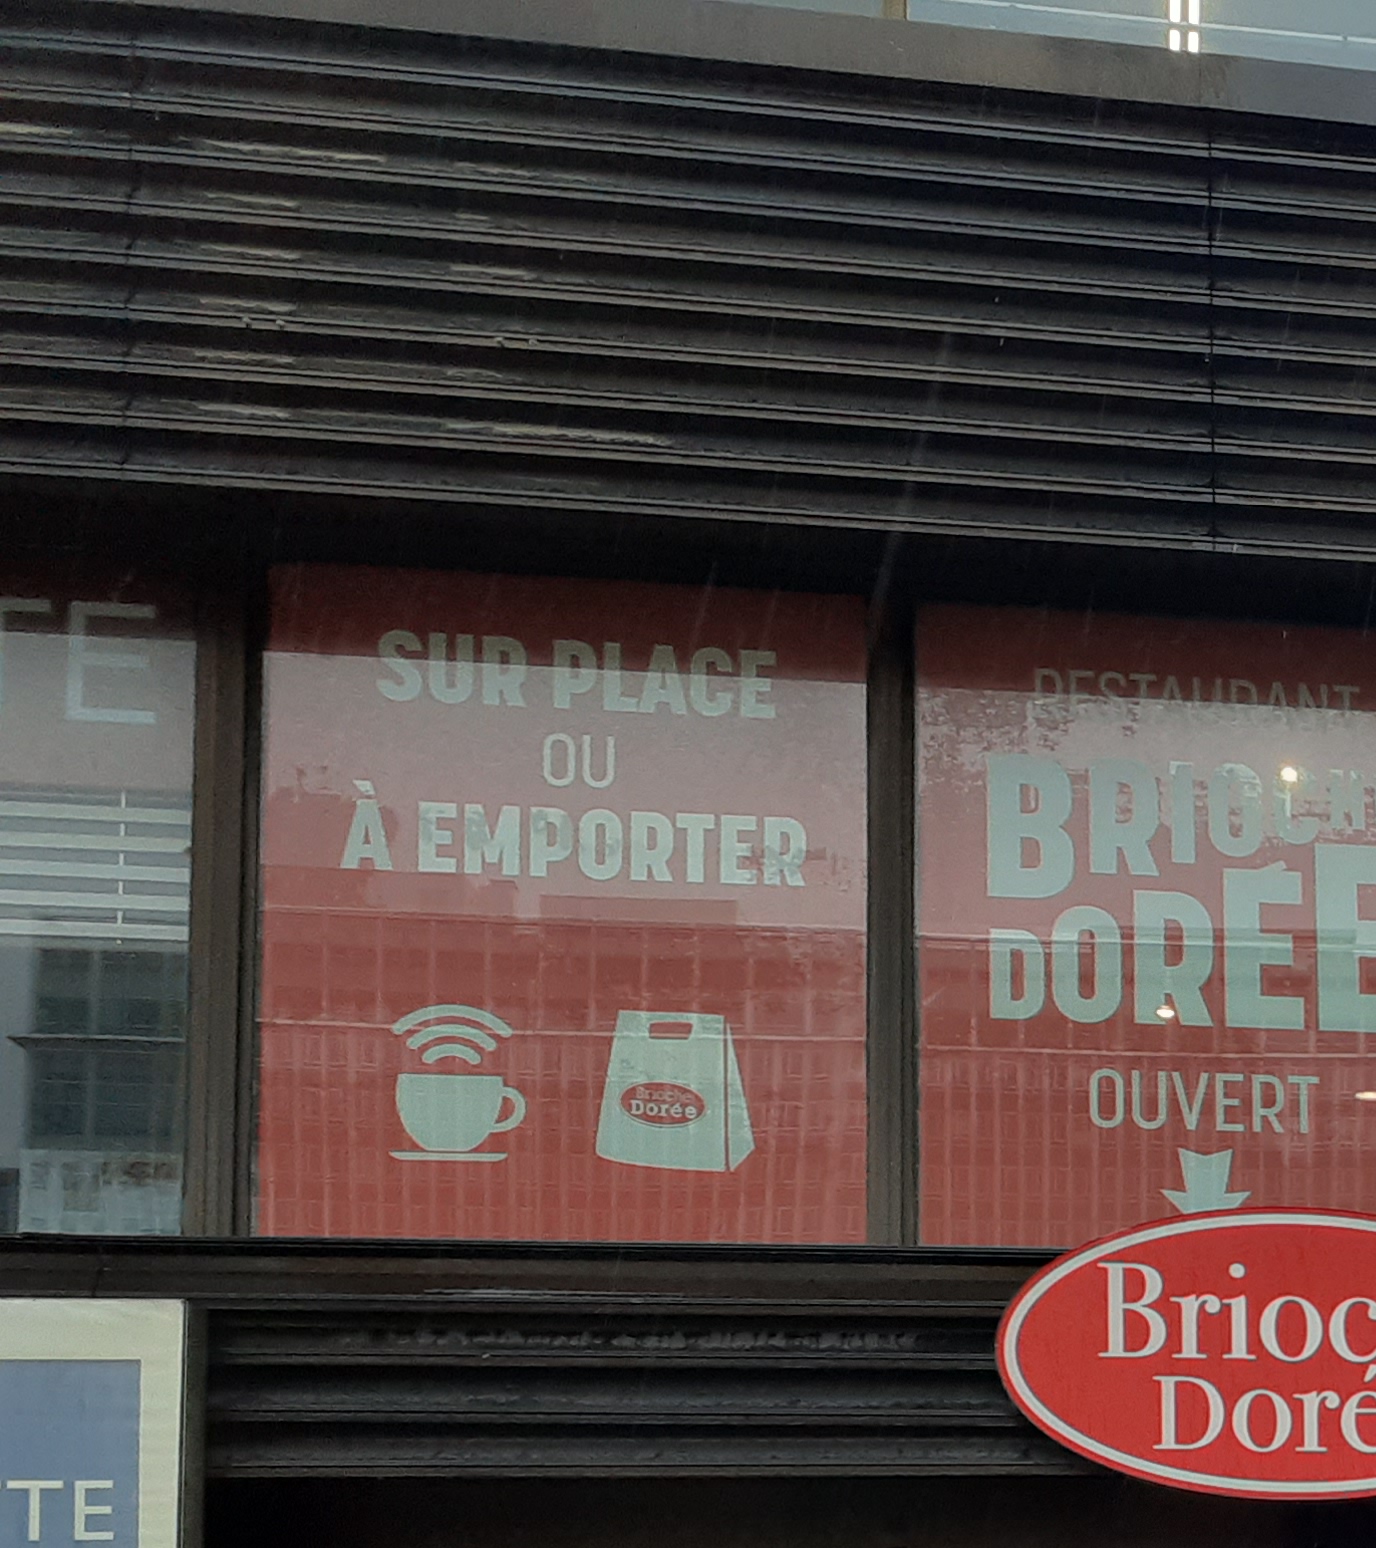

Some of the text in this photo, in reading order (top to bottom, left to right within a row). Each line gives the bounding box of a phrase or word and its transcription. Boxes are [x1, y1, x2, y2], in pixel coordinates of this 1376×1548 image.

[377, 629, 777, 720] SUR PLACE
[542, 733, 617, 789] OU
[340, 778, 807, 888] À EMPORTER
[629, 1099, 697, 1119] Dorée
[635, 1086, 694, 1103] Brioche
[1088, 1068, 1320, 1134] OUVERT
[6, 1479, 115, 1543] TE
